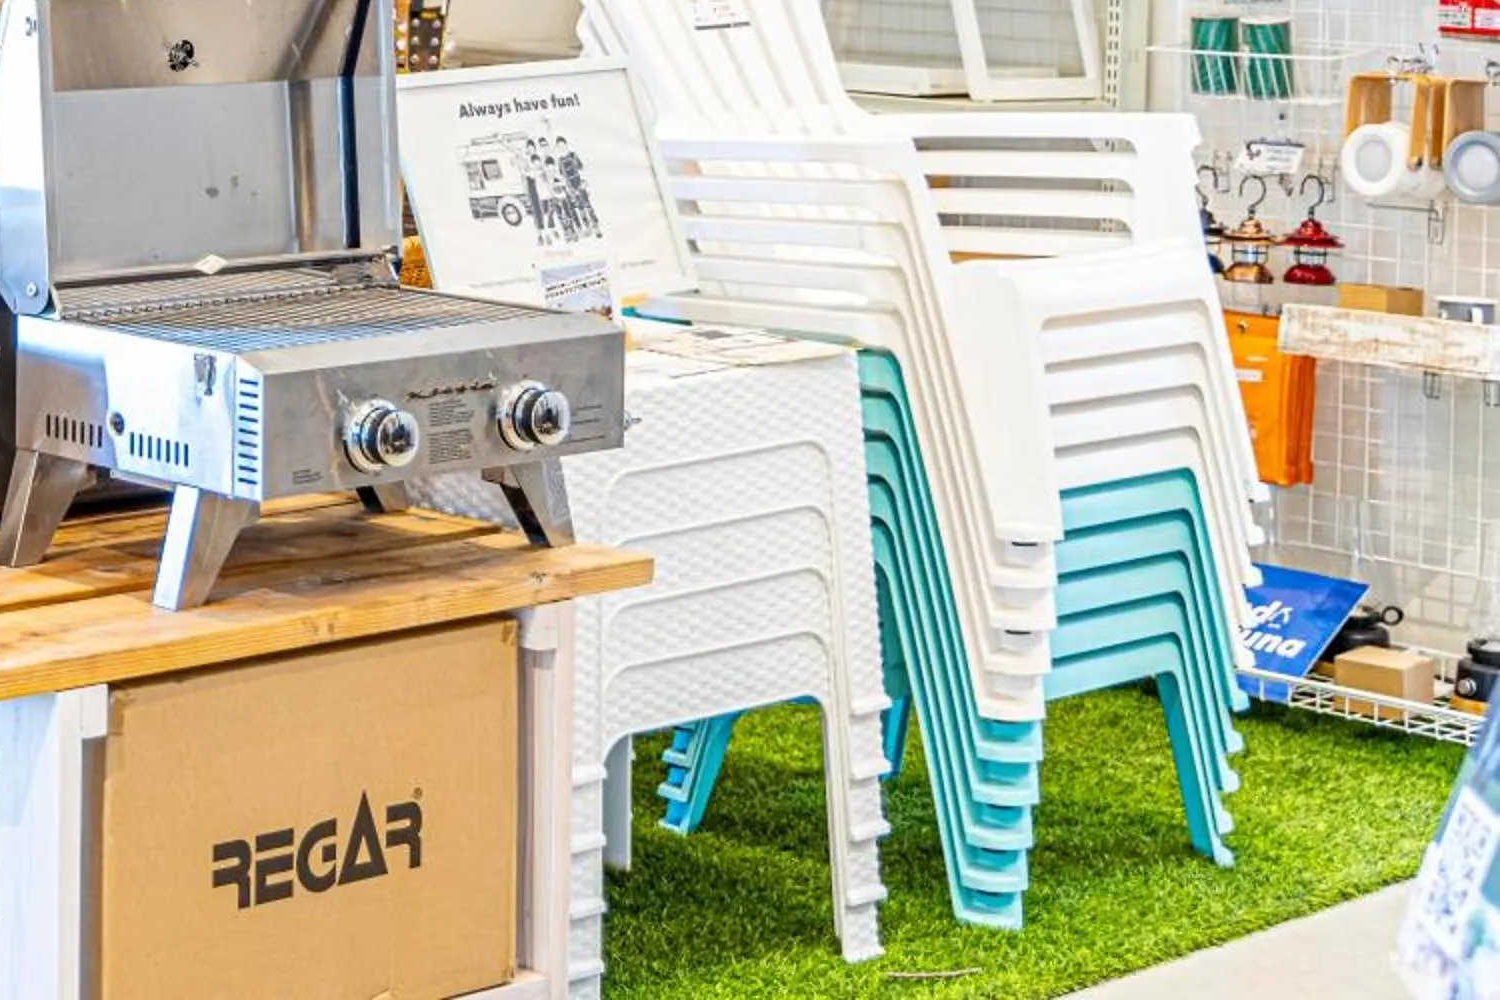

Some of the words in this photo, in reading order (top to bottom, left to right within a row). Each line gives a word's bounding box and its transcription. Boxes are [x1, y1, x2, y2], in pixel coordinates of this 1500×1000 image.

[459, 102, 512, 119] Always
[513, 97, 549, 112] have
[551, 92, 581, 108] fun!
[211, 788, 413, 912] REGAR
